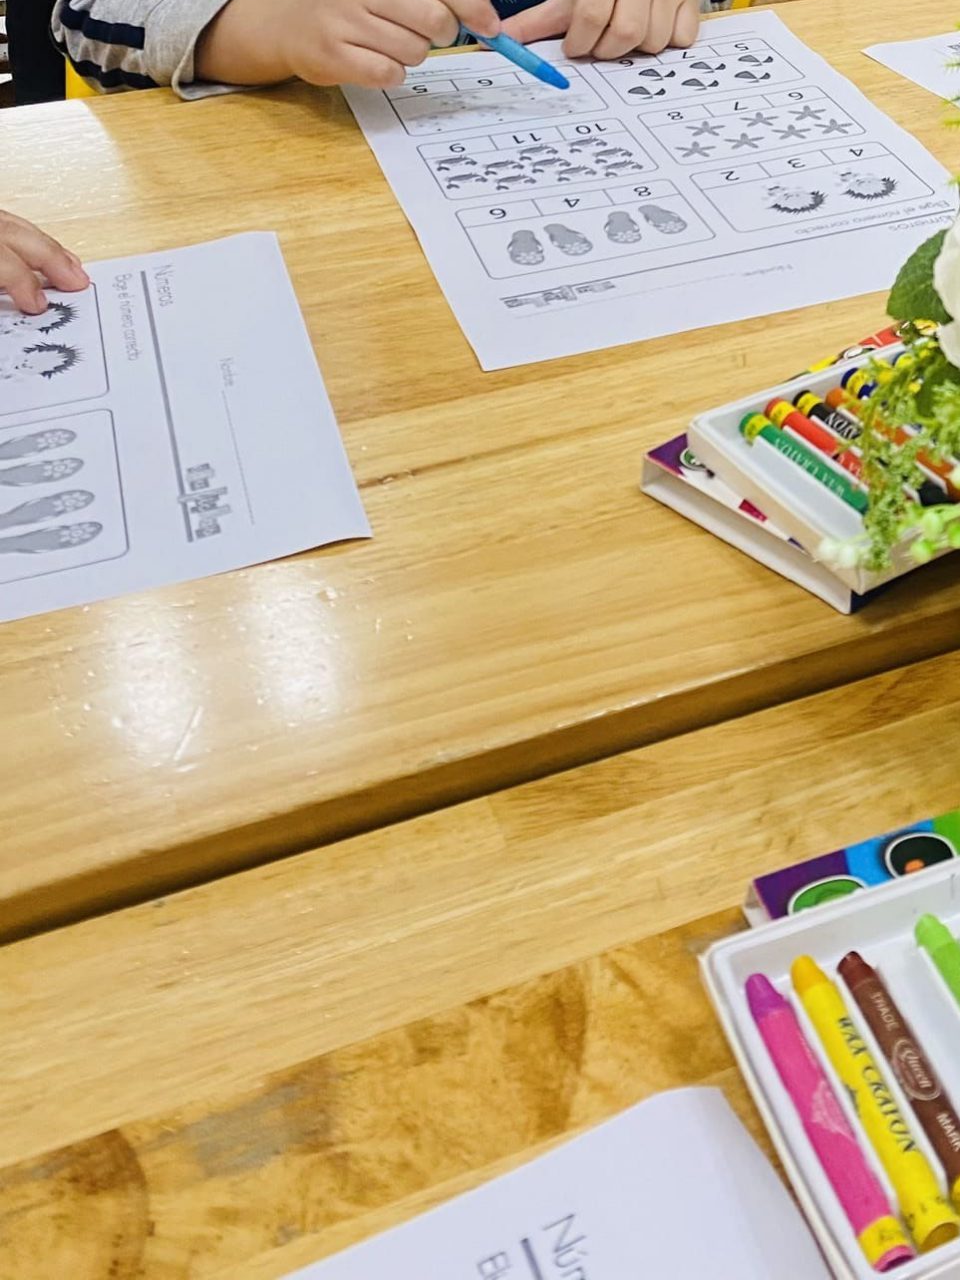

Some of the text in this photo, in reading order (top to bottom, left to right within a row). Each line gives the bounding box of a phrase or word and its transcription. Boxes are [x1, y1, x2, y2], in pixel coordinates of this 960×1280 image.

[733, 42, 749, 51] 5
[682, 51, 697, 60] 7
[412, 84, 428, 94] 5
[734, 101, 748, 112] 7
[667, 111, 683, 121] 8
[575, 122, 607, 135] 10
[512, 132, 541, 144] 11
[720, 148, 864, 182] 4 3 2
[633, 186, 651, 197] 8
[563, 198, 580, 208] 4
[899, 1049, 933, 1089] Queen
